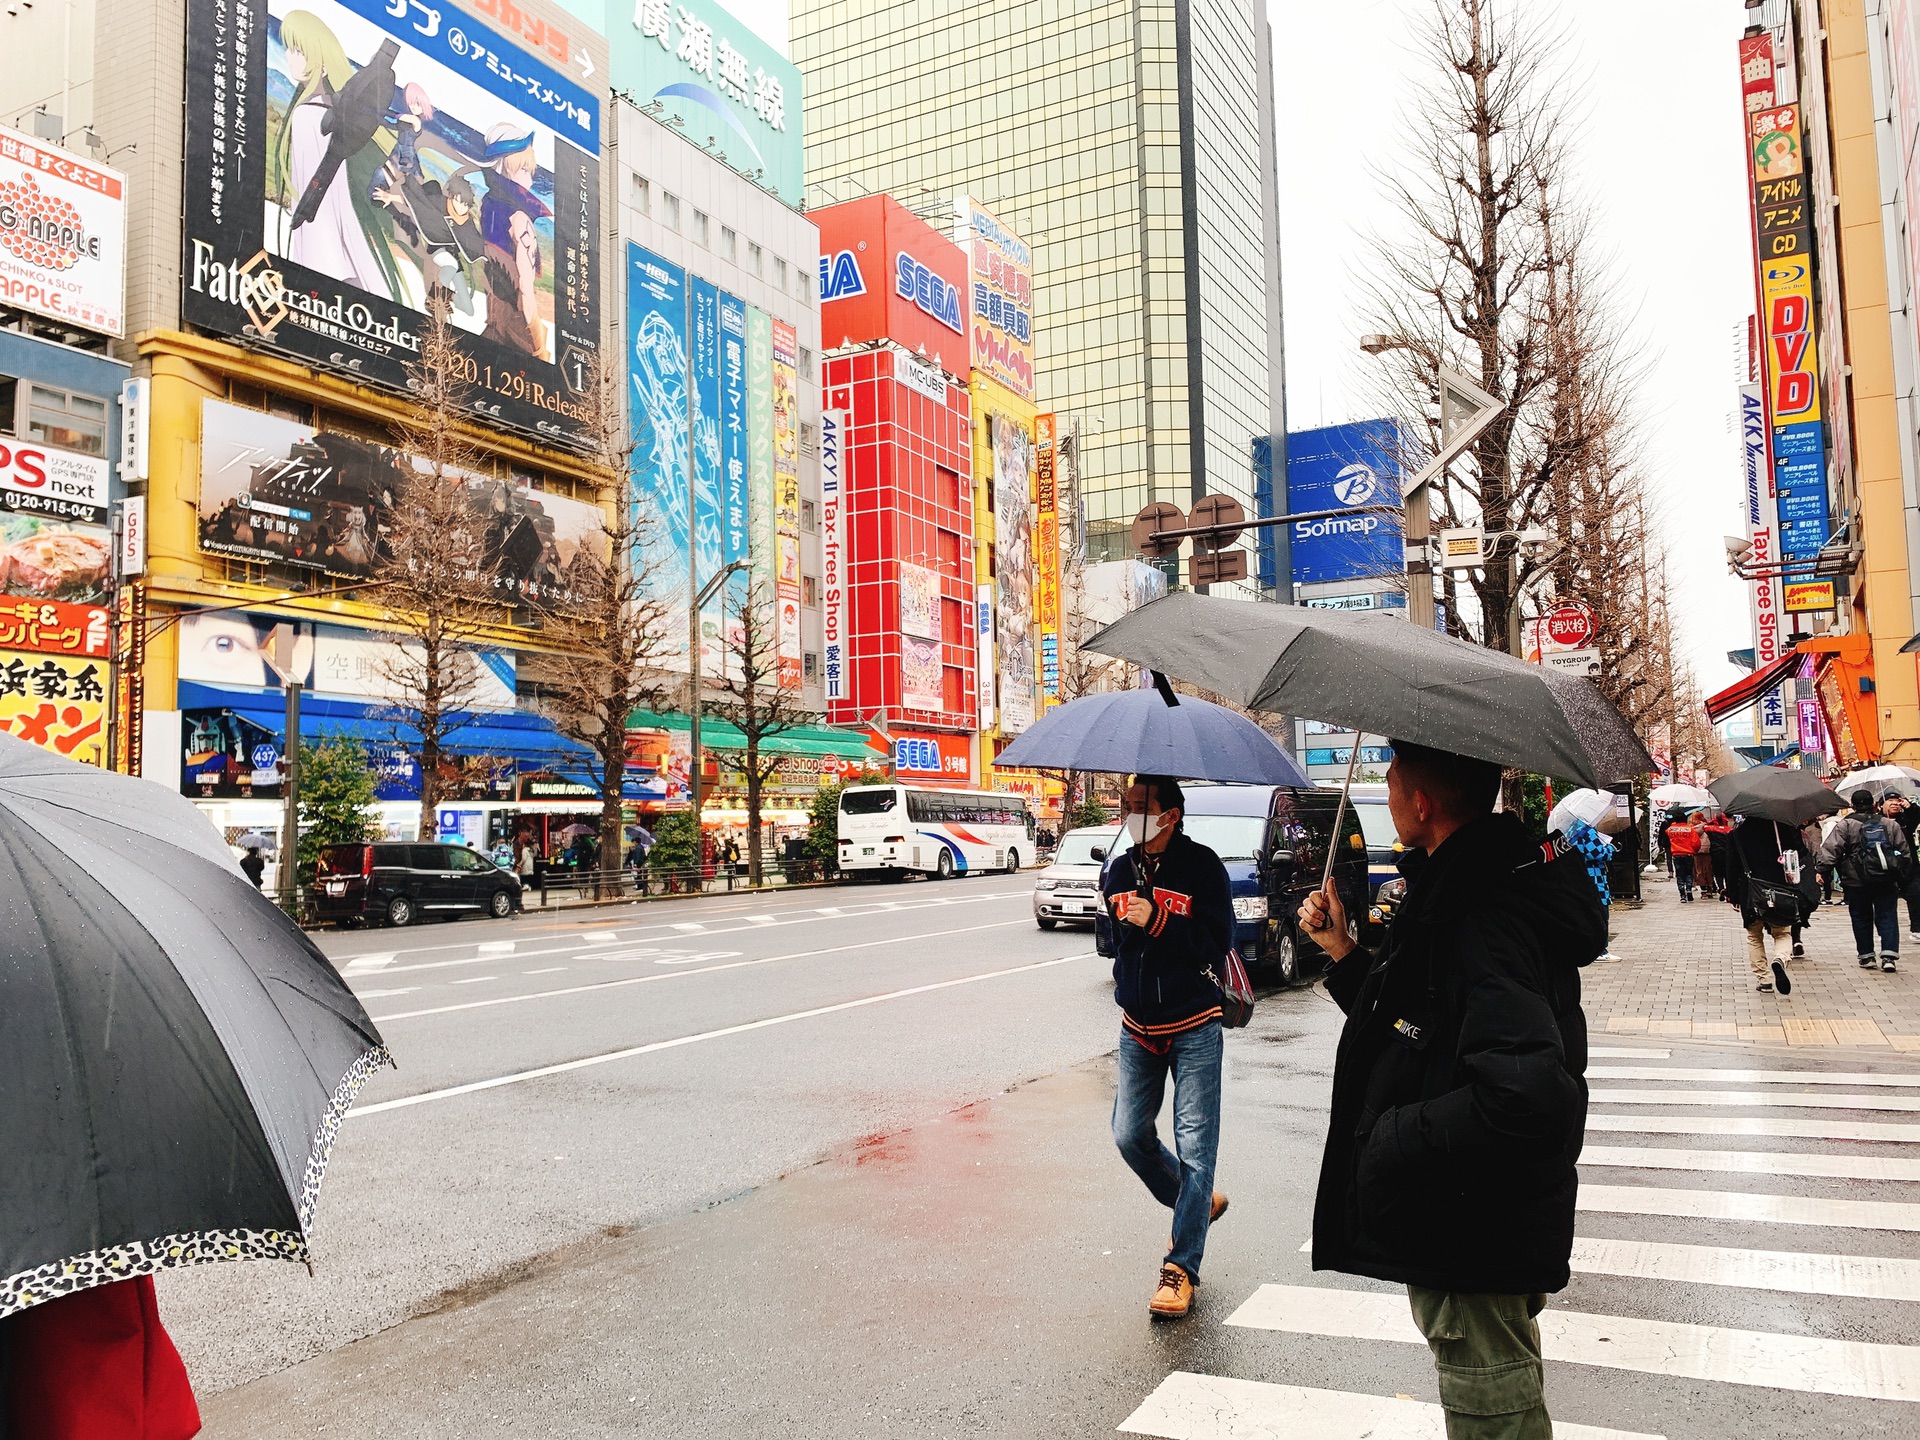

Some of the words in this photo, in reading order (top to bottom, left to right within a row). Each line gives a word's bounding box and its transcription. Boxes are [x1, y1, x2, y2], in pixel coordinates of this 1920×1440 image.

[1760, 178, 1801, 204] アイドル
[1763, 205, 1802, 229] アニメ
[28, 215, 100, 260] APPLE
[1772, 233, 1797, 254] CD
[55, 278, 83, 294] SLOT
[189, 238, 254, 310] Fate
[344, 303, 422, 353] Order
[896, 251, 963, 336] SEGA
[973, 281, 1031, 346] 高額買取
[974, 324, 1034, 392] Mulan
[1770, 294, 1815, 417] DVD
[573, 362, 585, 392] 1
[909, 364, 944, 395] MC-UBS
[532, 382, 596, 425] Release
[822, 415, 838, 472] AKKY
[1775, 426, 1786, 435] 5F
[725, 339, 744, 551] 電子マネー使えます
[51, 457, 97, 475] リアルタイム
[1777, 457, 1789, 466] 4F
[51, 480, 96, 500] next
[1779, 489, 1791, 498] 3F
[5, 491, 96, 520] 0120-915-047
[127, 512, 137, 558] GPS
[249, 514, 300, 536] 配信開始
[1295, 516, 1378, 539] Sofmap
[1741, 392, 1764, 456] AKKY
[1757, 612, 1777, 662] Shop
[1781, 521, 1793, 530] 2F
[823, 497, 841, 586] Tax-free
[1783, 553, 1795, 561] 1F
[825, 587, 841, 642] Shop
[979, 602, 990, 635] SEGA
[1551, 617, 1586, 635] 消火栓
[1551, 655, 1592, 665] TOYGROUP
[254, 750, 275, 763] 437
[790, 757, 819, 771] Shop
[896, 738, 942, 771] SEGA
[944, 755, 968, 773] 3号館
[1371, 909, 1381, 918] 05
